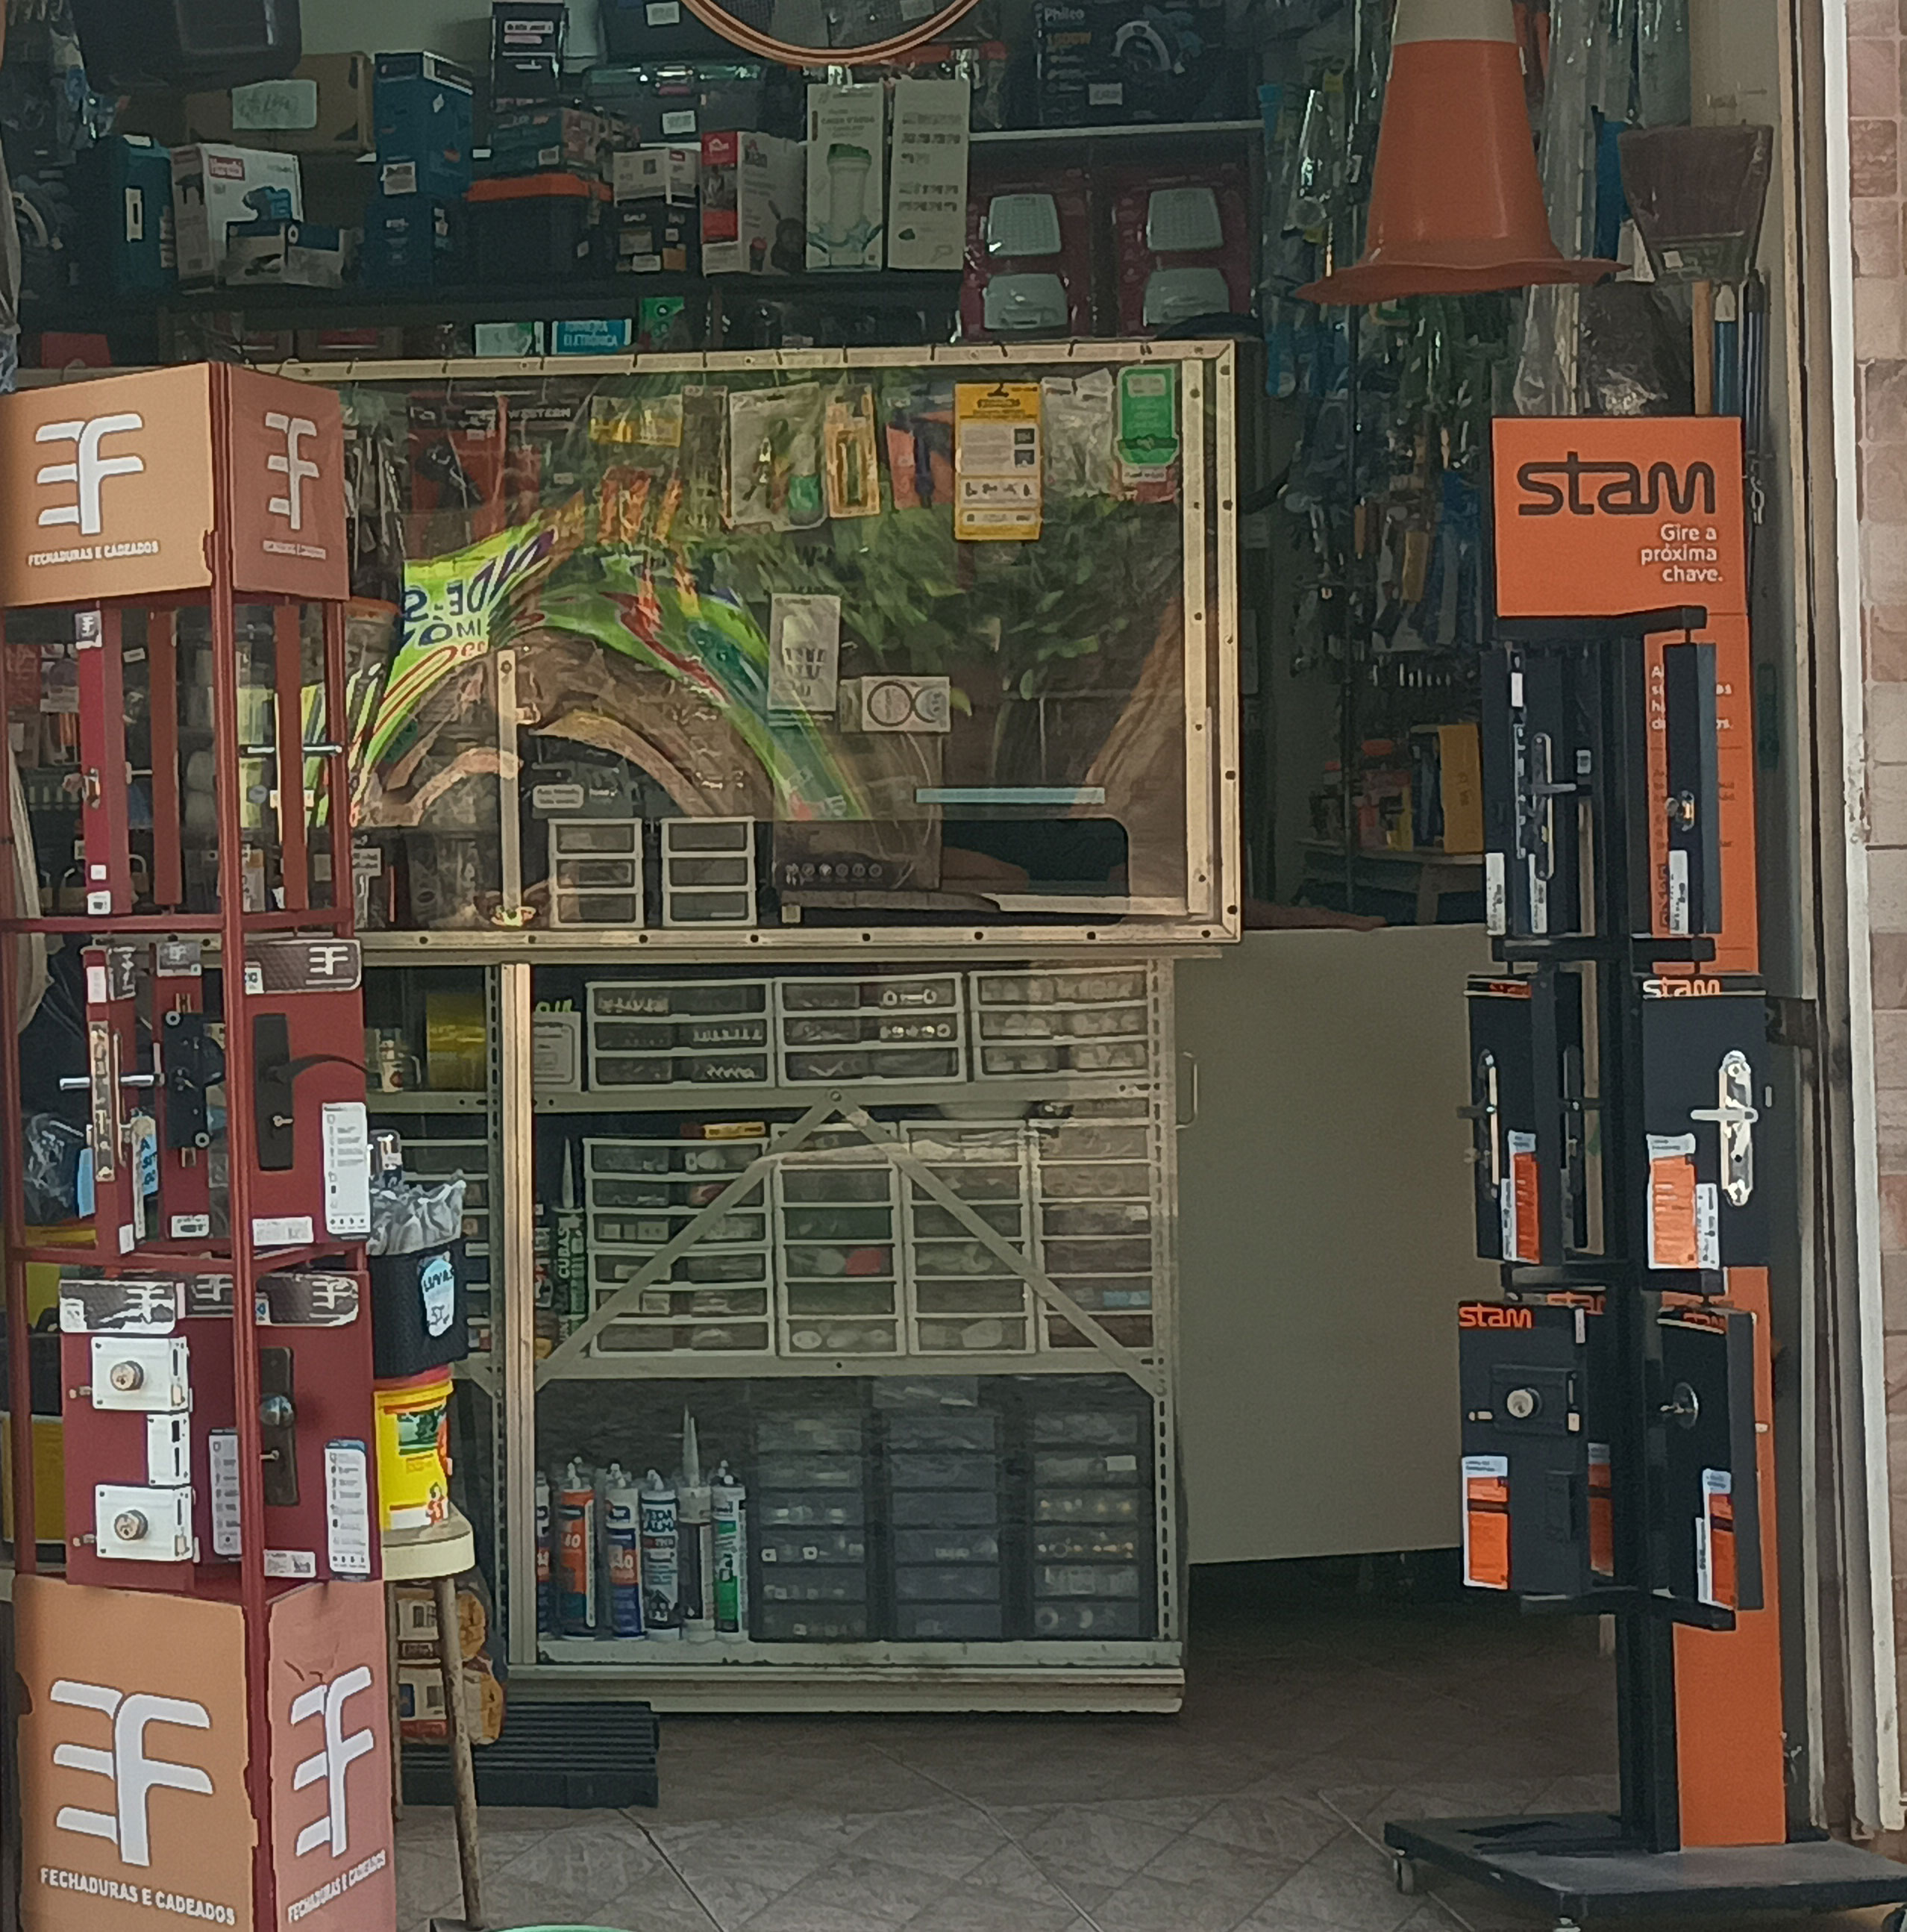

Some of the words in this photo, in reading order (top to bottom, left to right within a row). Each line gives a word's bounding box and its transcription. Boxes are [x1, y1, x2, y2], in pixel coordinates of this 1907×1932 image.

[1517, 451, 1715, 516] stam
[1661, 523, 1700, 541] Gire
[1706, 528, 1717, 540] a
[95, 545, 102, 559] E
[1641, 544, 1717, 566] próxima
[1662, 566, 1723, 582] chave.
[1643, 977, 1720, 998] stam
[1459, 1303, 1532, 1329] stam
[40, 1867, 138, 1904] FECHADURAS
[142, 1888, 152, 1907] E
[155, 1891, 237, 1927] CADEADOS
